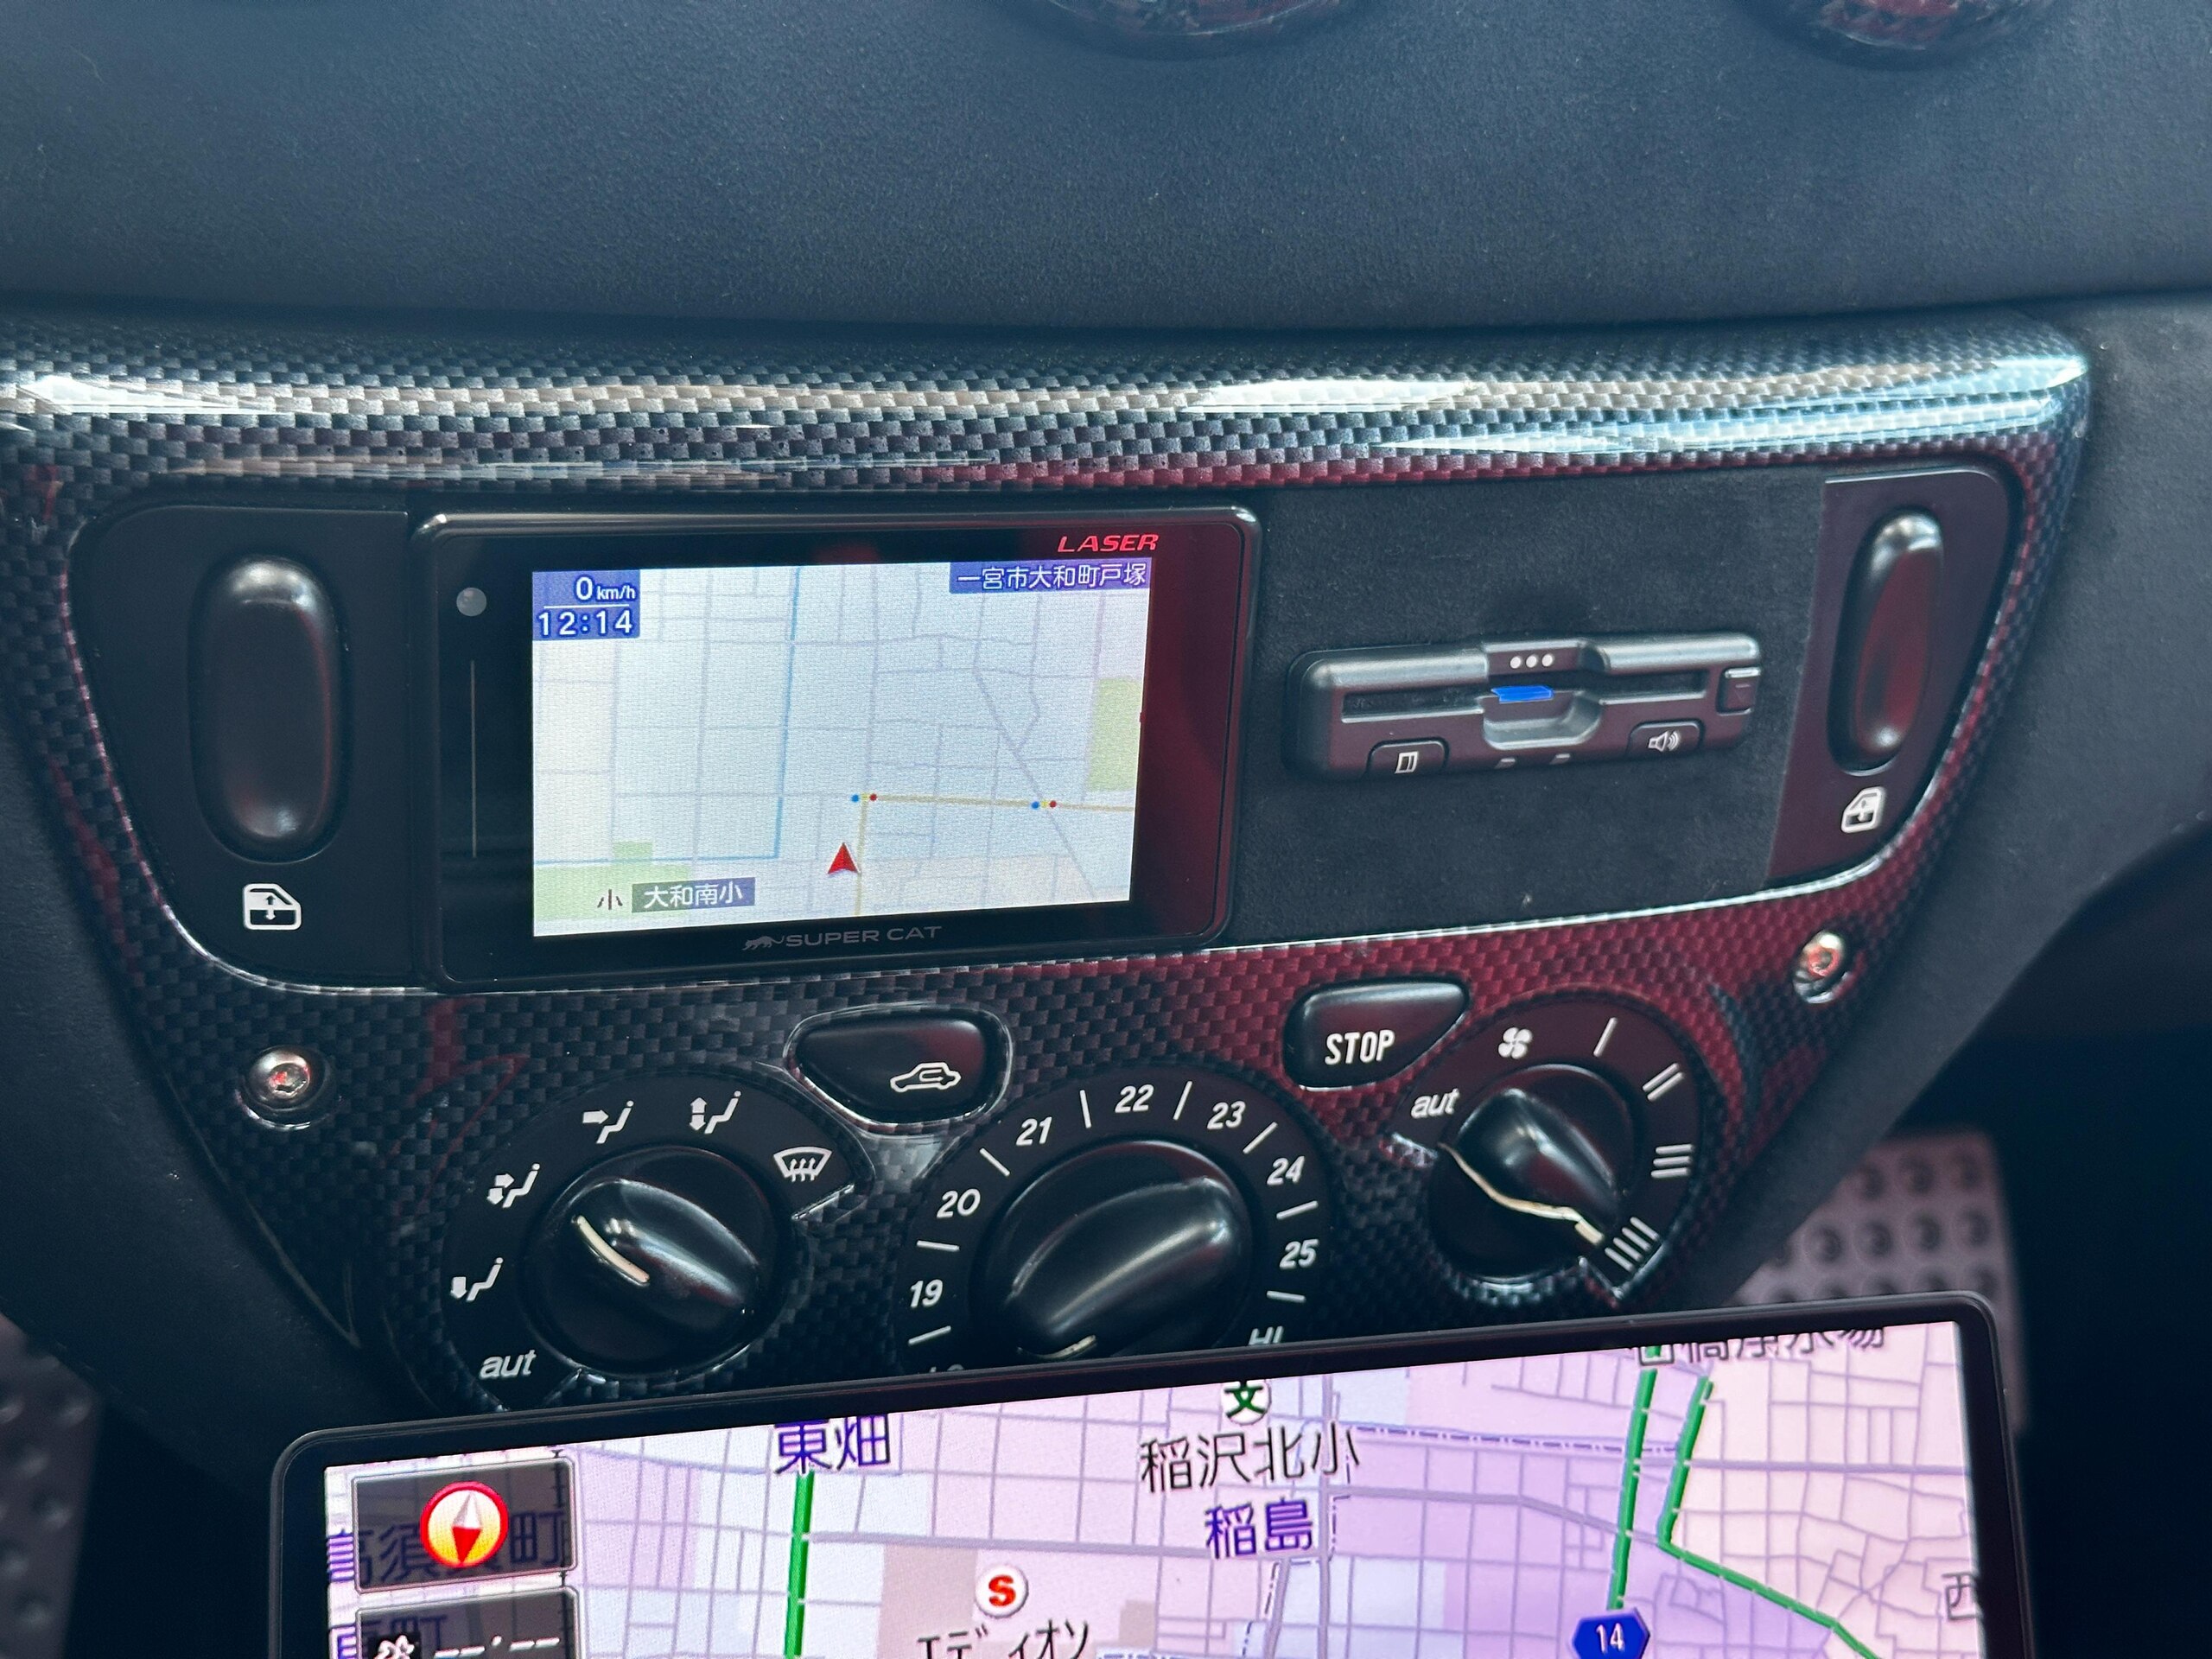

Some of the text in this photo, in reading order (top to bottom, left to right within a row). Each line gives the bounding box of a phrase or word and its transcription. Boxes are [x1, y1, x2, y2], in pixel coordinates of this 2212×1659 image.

[1057, 533, 1160, 554] LASER
[575, 575, 636, 601] 0 km/h
[957, 562, 1147, 590] 一宮市大和町戸塚
[538, 609, 633, 636] 12:14
[643, 880, 745, 910] 大和南小
[785, 925, 944, 948] SUPER CAT
[1325, 1029, 1395, 1065] STOP
[1114, 1084, 1154, 1114] 22
[1410, 1088, 1460, 1119] aut
[1206, 1100, 1246, 1130] 23
[1015, 1116, 1052, 1147] 21
[1266, 1155, 1305, 1185] 24
[936, 1188, 981, 1218] 20
[1279, 1238, 1319, 1269] 25
[910, 1279, 944, 1308] 19
[479, 1349, 537, 1379] aut
[774, 1415, 891, 1474] 東畑
[1139, 1421, 1361, 1493] 稲沢北小
[1205, 1497, 1313, 1560] 稲島
[1596, 1623, 1625, 1655] 14
